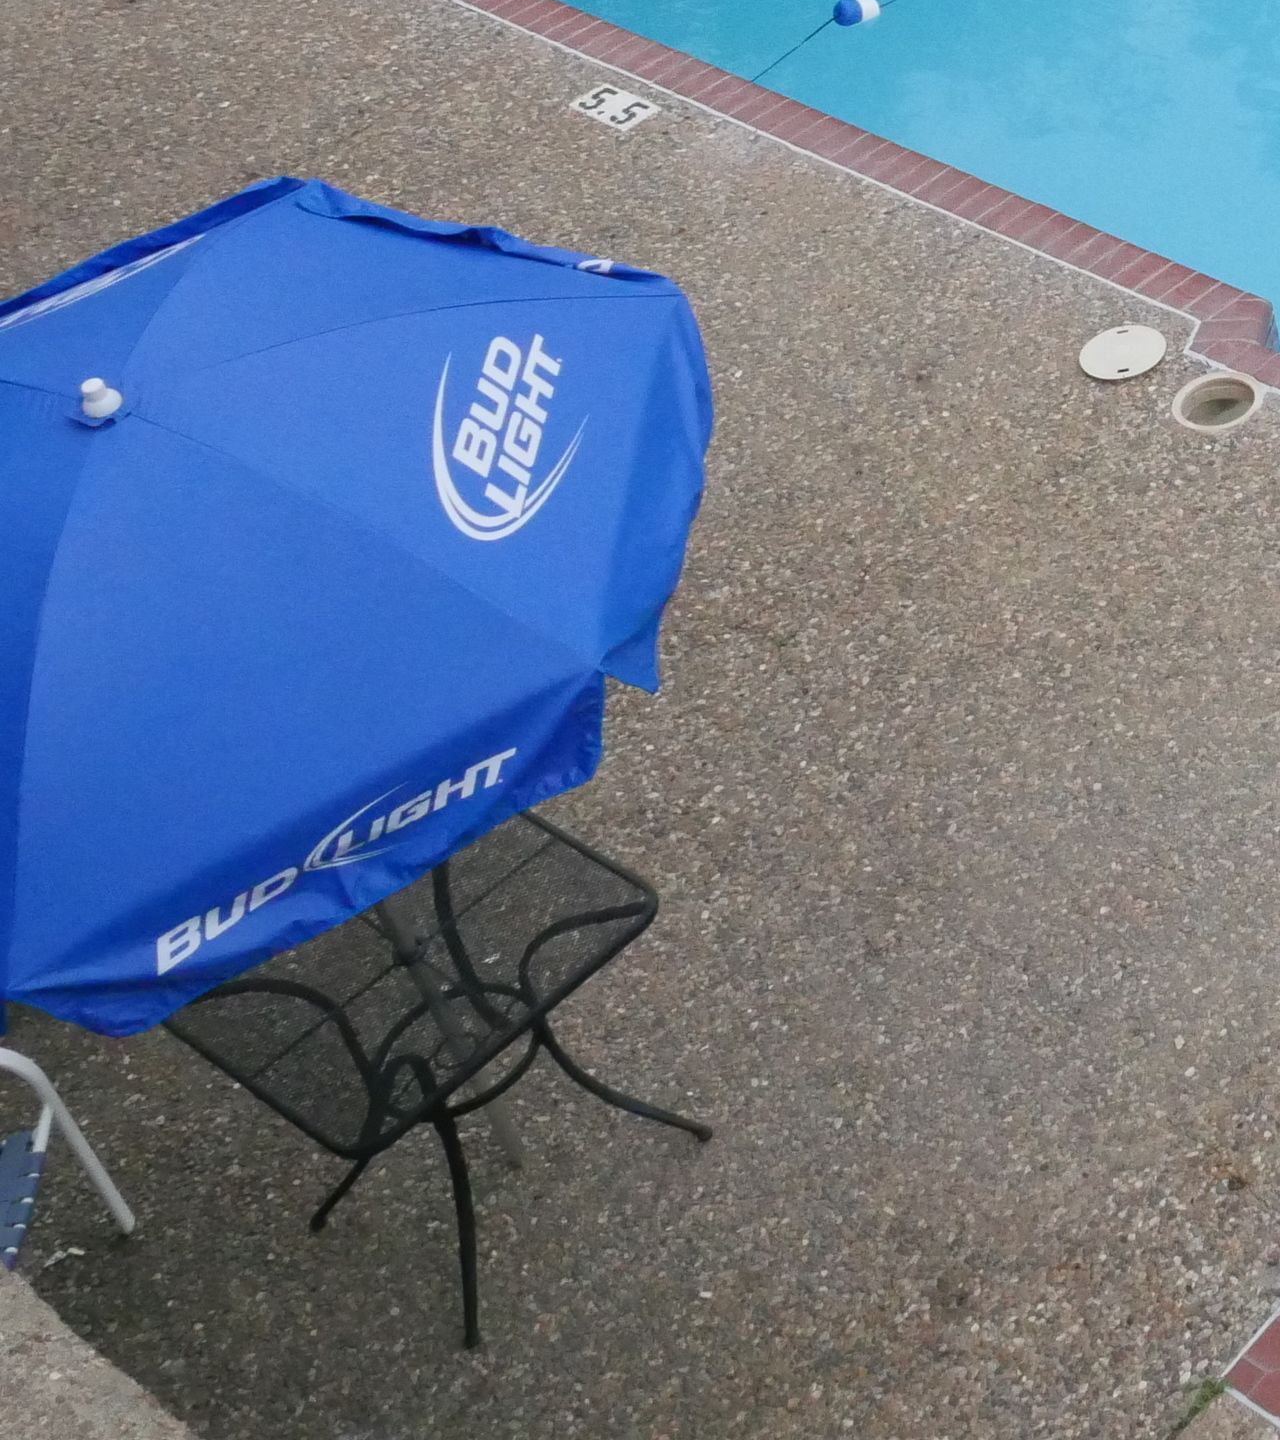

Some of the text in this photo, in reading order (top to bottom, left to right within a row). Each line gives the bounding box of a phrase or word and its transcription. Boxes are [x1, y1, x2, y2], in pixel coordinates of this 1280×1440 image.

[578, 88, 651, 125] 5.5
[452, 336, 522, 479] BUD
[484, 333, 562, 519] LIGHT
[156, 746, 518, 976] BUD LIGHT
